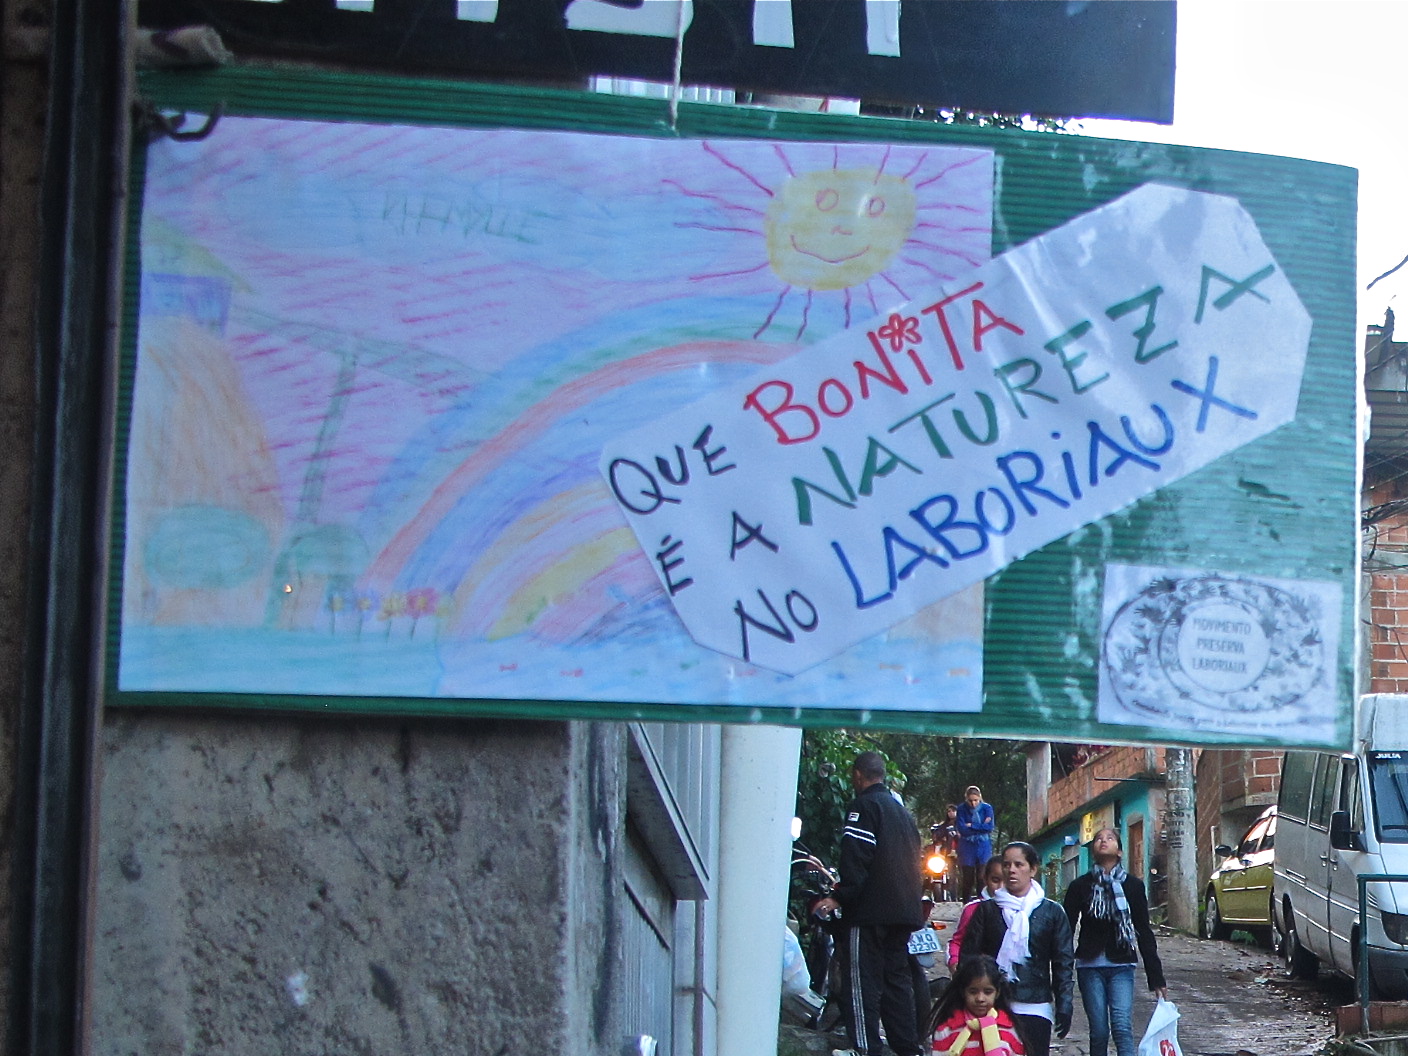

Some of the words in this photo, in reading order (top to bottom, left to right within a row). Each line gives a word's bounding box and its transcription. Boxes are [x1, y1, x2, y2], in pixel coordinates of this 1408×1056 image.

[656, 534, 693, 597] É
[730, 511, 779, 561] A
[791, 264, 1275, 526] NATUREZA
[609, 424, 736, 515] QUE
[734, 588, 820, 662] NO
[1192, 617, 1252, 635] MOVIMENTO
[1196, 637, 1245, 654] PRESERVA
[1191, 657, 1248, 674] LABORIAUX
[910, 941, 938, 953] 3230
